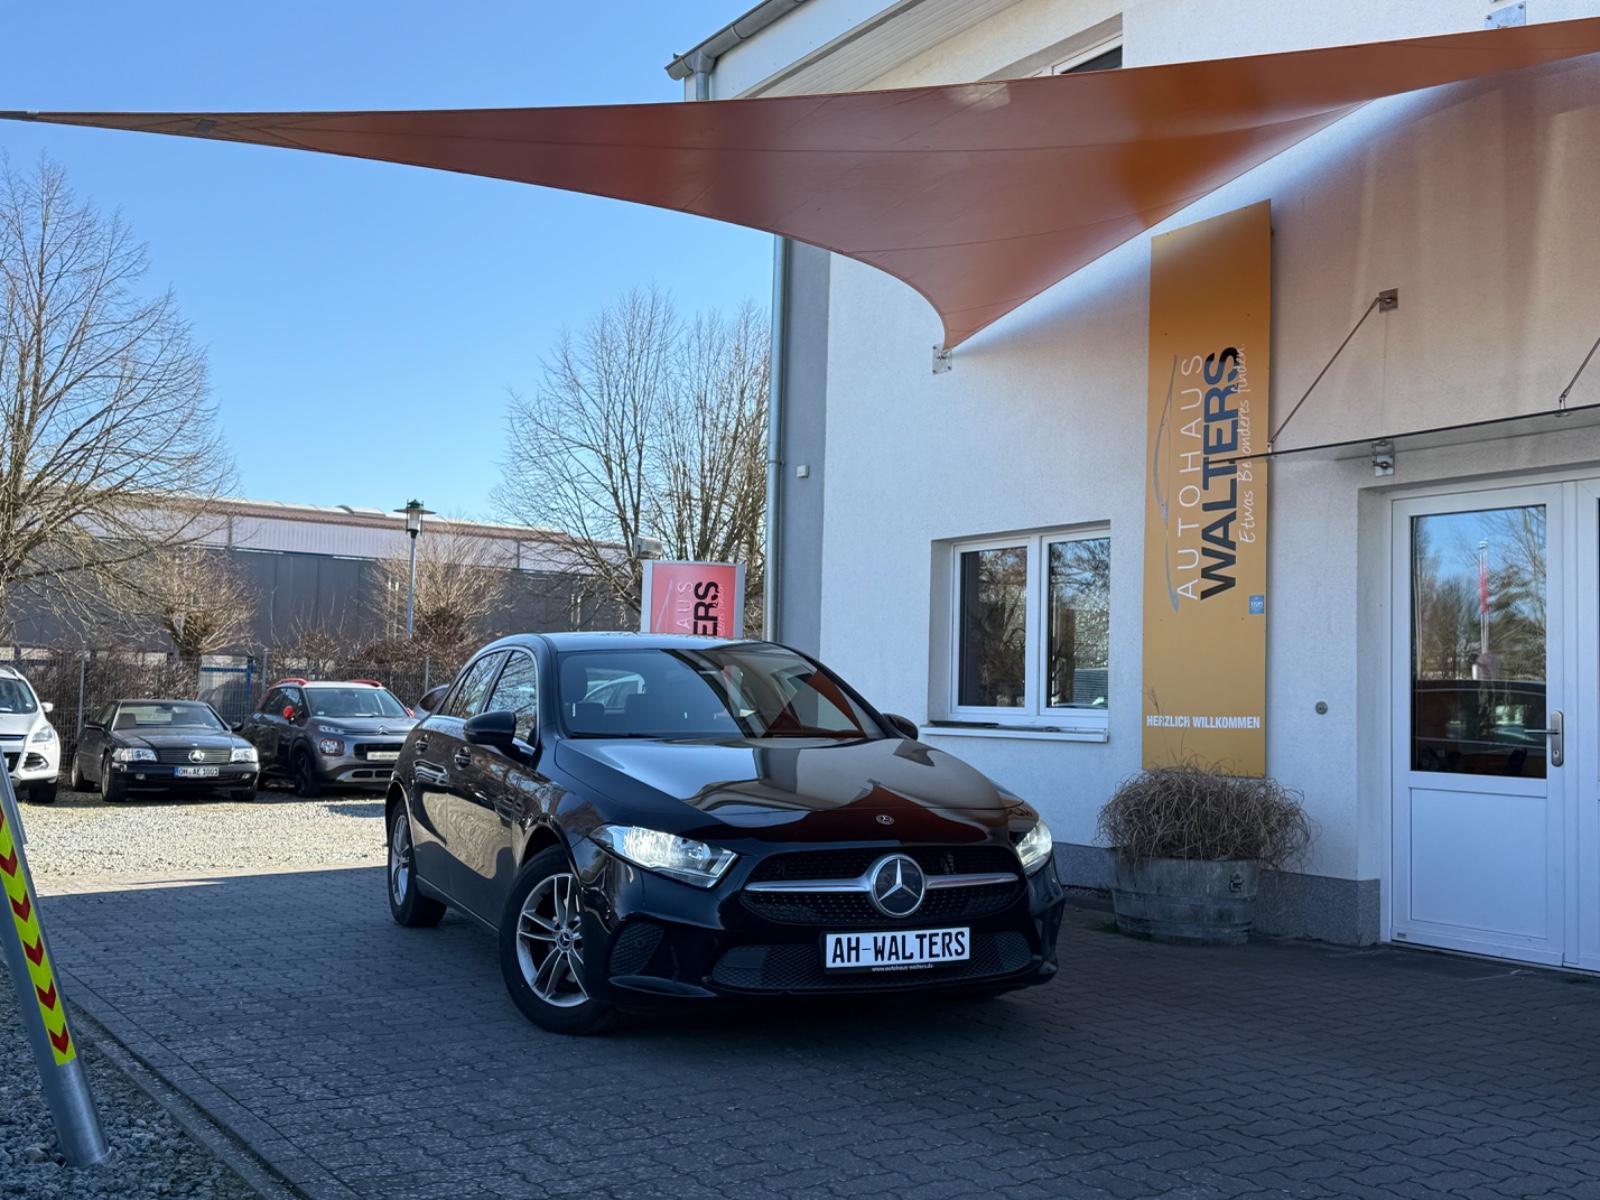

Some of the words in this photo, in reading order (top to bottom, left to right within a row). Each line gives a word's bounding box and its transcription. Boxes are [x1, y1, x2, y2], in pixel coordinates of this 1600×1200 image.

[1200, 347, 1237, 600] WALTERS
[1236, 398, 1253, 482] Beonderes
[1177, 355, 1202, 600] AUTOHAUS
[1239, 490, 1256, 543] Etwas
[1146, 715, 1191, 728] HERZLICH
[1192, 716, 1260, 729] WILLKOMMEN
[831, 931, 966, 964] AH-WALTERS
